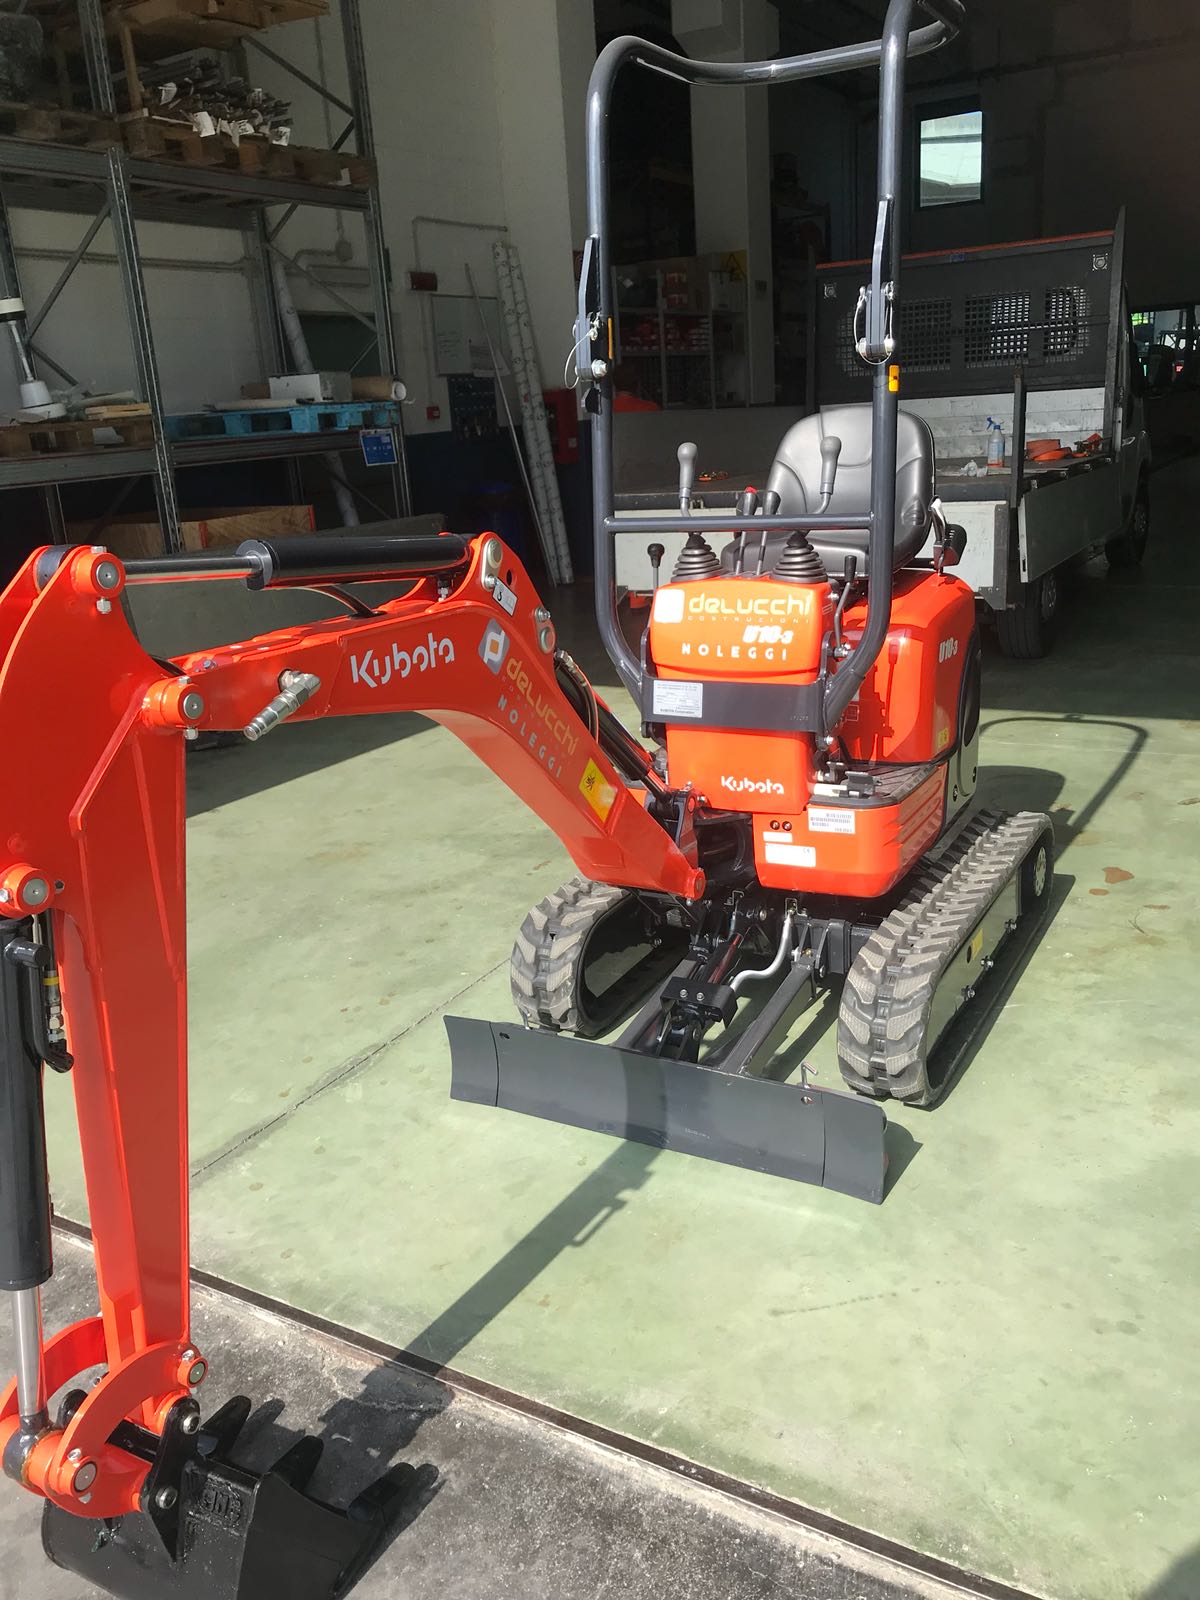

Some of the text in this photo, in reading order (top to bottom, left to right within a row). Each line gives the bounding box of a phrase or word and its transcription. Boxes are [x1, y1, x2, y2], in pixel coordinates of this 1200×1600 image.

[687, 615, 809, 624] COSTRUZIONI
[350, 632, 455, 688] Kubota
[681, 642, 787, 661] NOLEGGI
[498, 694, 562, 778] NOLEGGI
[720, 775, 785, 795] Kubota
